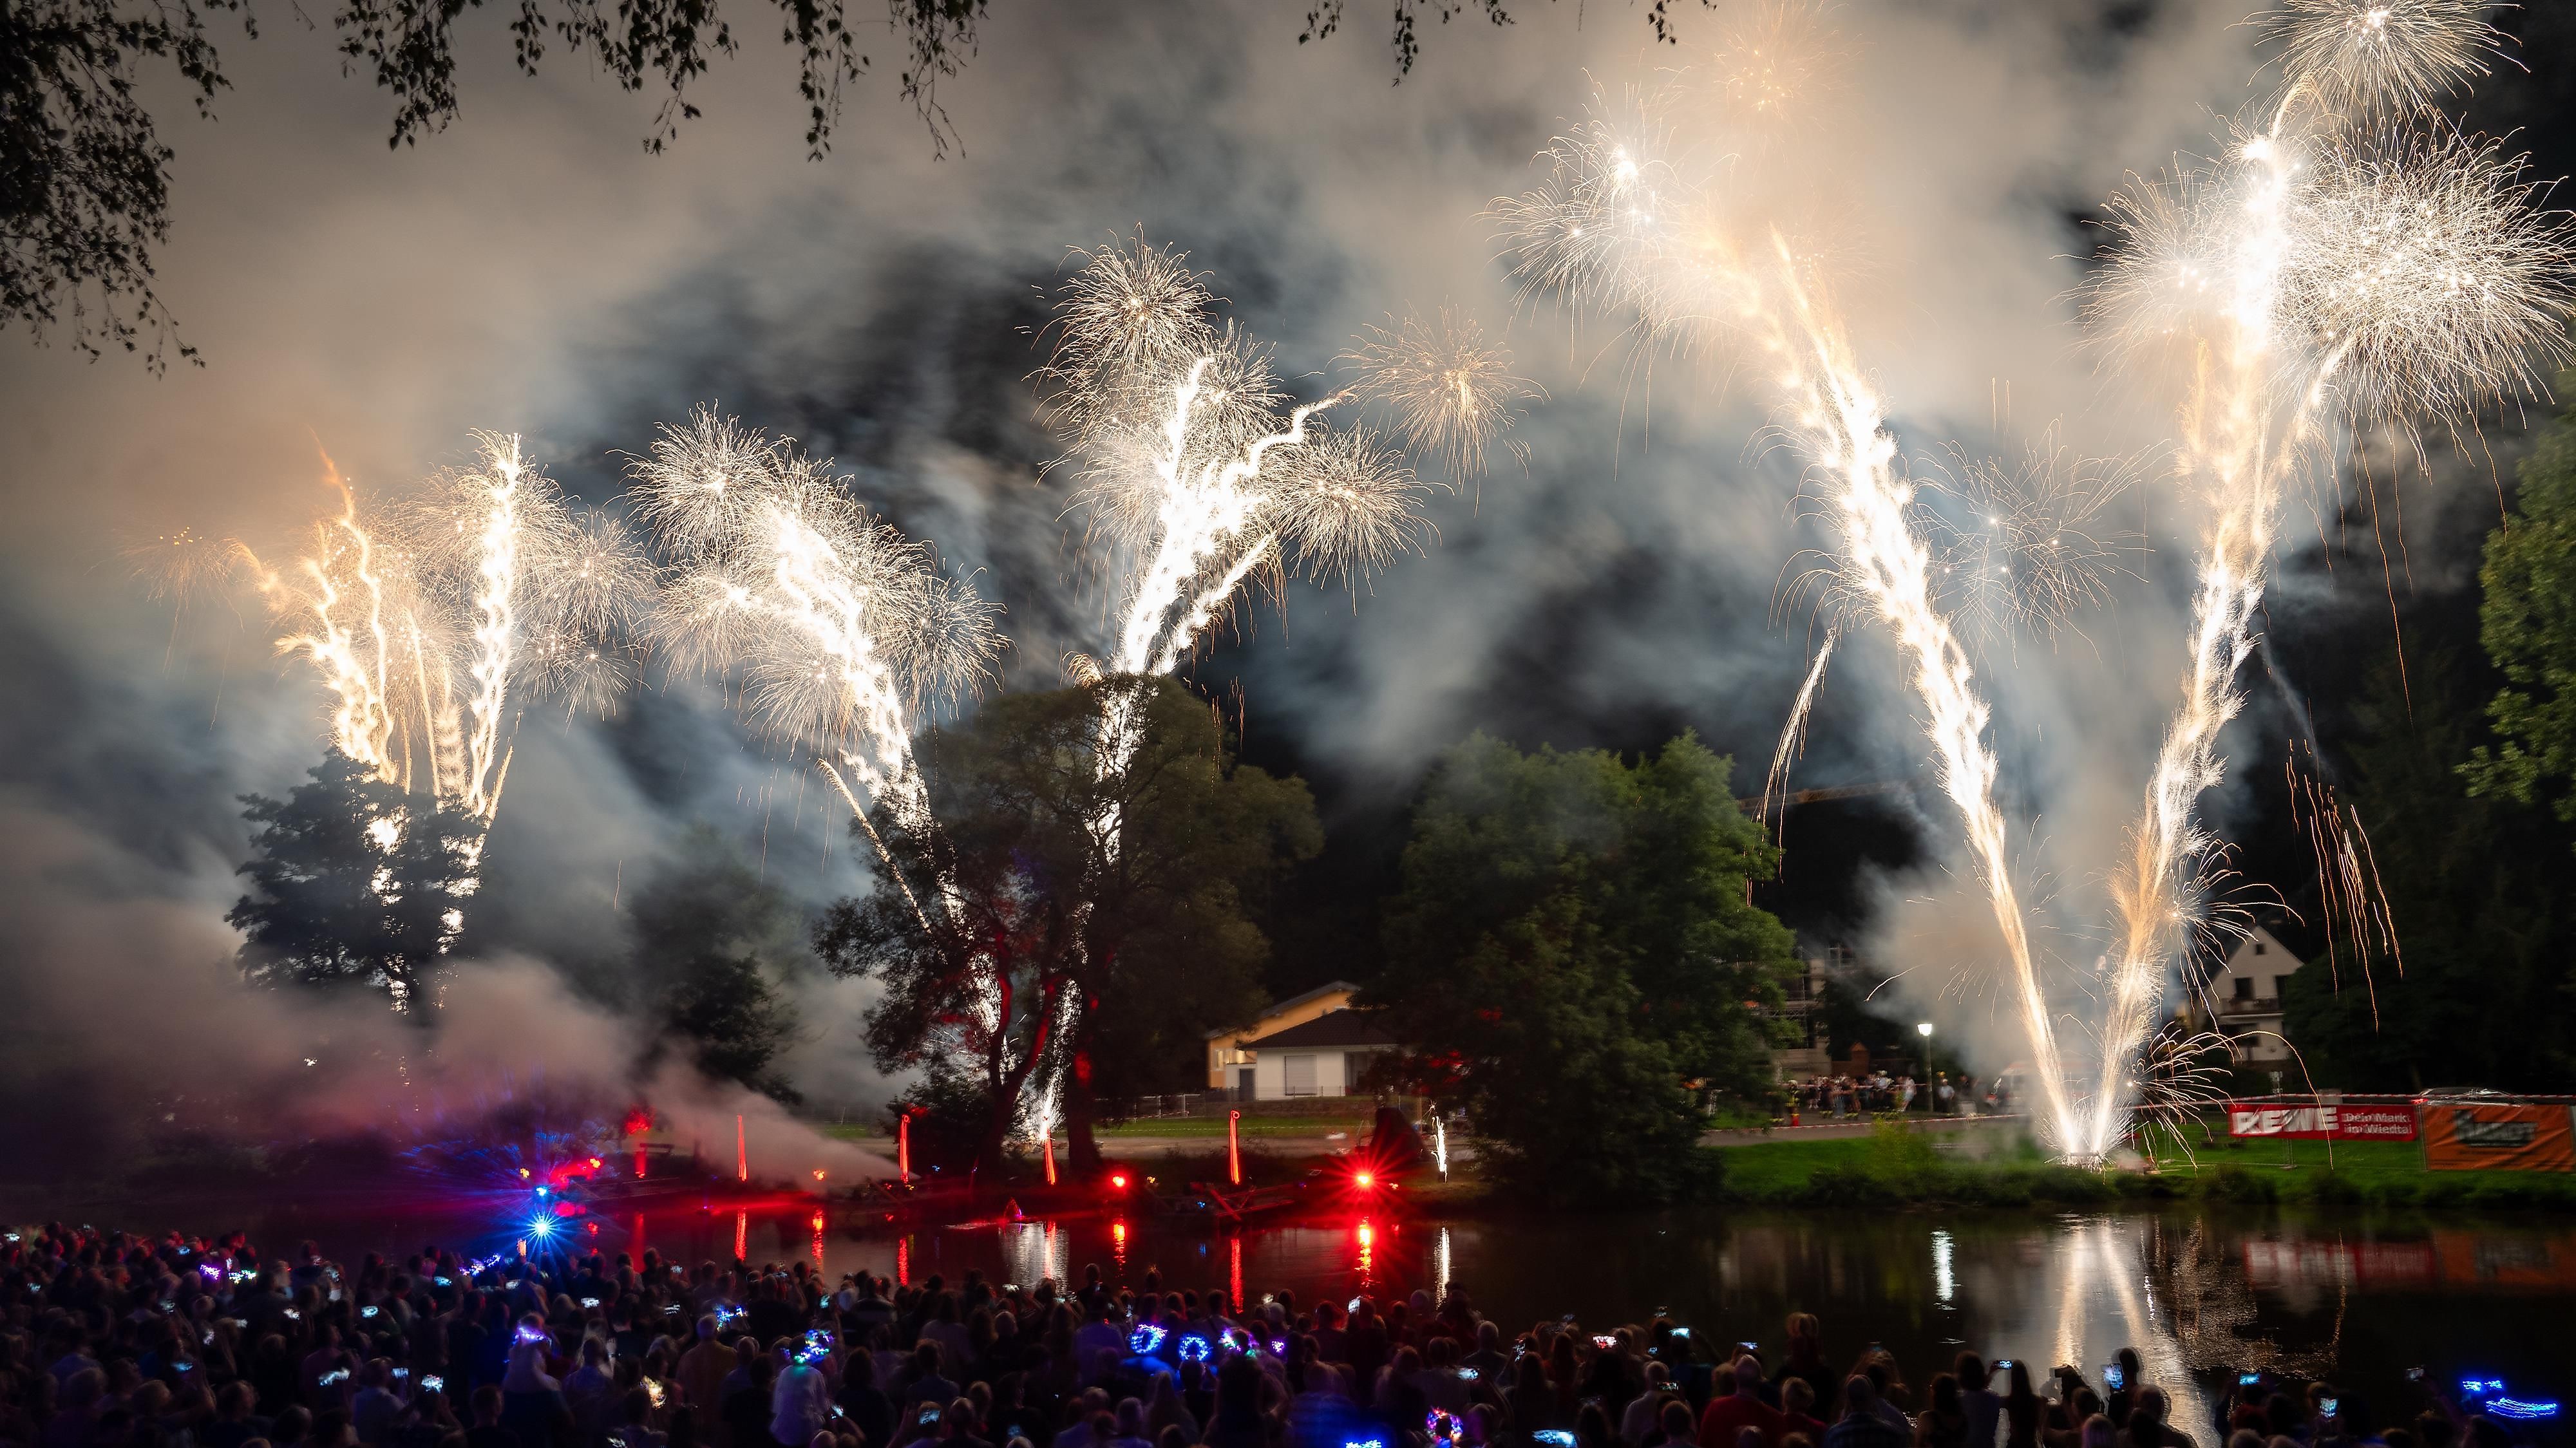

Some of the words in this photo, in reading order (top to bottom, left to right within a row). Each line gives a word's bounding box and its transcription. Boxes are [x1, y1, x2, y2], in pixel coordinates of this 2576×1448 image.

[2231, 1107, 2339, 1134] REWE
[2342, 1113, 2371, 1122] Dein
[2373, 1113, 2412, 1122] Markt
[2344, 1124, 2363, 1134] im
